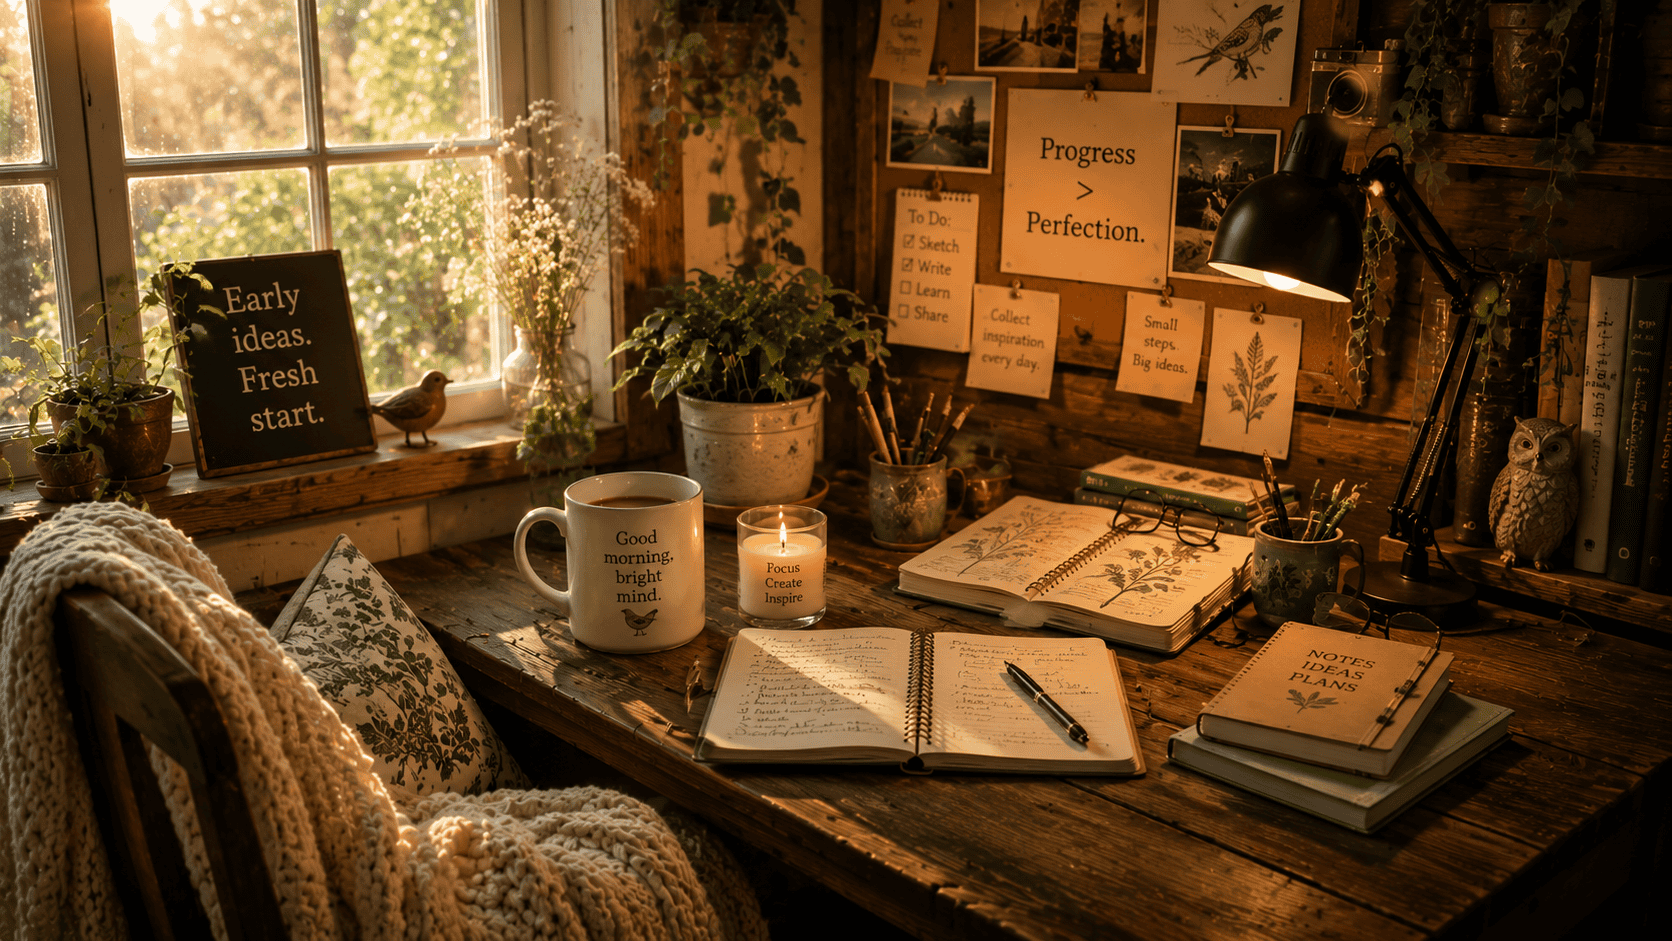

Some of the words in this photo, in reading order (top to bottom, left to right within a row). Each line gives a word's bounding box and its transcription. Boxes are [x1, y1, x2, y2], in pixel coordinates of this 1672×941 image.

[1040, 137, 1136, 168] Progress
[1076, 181, 1093, 200] >
[908, 209, 924, 224] To
[929, 211, 951, 227] Do:
[1026, 211, 1145, 243] Perfection.
[919, 236, 960, 254] Sketch
[918, 259, 952, 276] Write
[222, 281, 300, 316] Early
[916, 282, 951, 299] Learn
[914, 305, 949, 323] Share
[990, 308, 1031, 326] Collect
[1144, 315, 1178, 331] Small
[231, 324, 312, 354] ideas.
[983, 328, 1045, 349] inspiration
[1143, 336, 1180, 353] steps.
[981, 353, 1012, 370] every
[1016, 353, 1040, 374] day.
[1132, 353, 1151, 373] Big
[1155, 357, 1188, 374] ideas.
[237, 358, 320, 393] Fresh
[250, 401, 325, 432] start.
[615, 528, 658, 546] Good
[603, 550, 674, 566] morning,
[615, 568, 663, 588] bright
[764, 577, 803, 589] Create
[616, 587, 662, 603] mind.
[764, 592, 804, 607] Inspire
[1306, 649, 1376, 669] NOTES
[1301, 661, 1365, 680] IDEAS
[1288, 672, 1359, 693] PLANS
